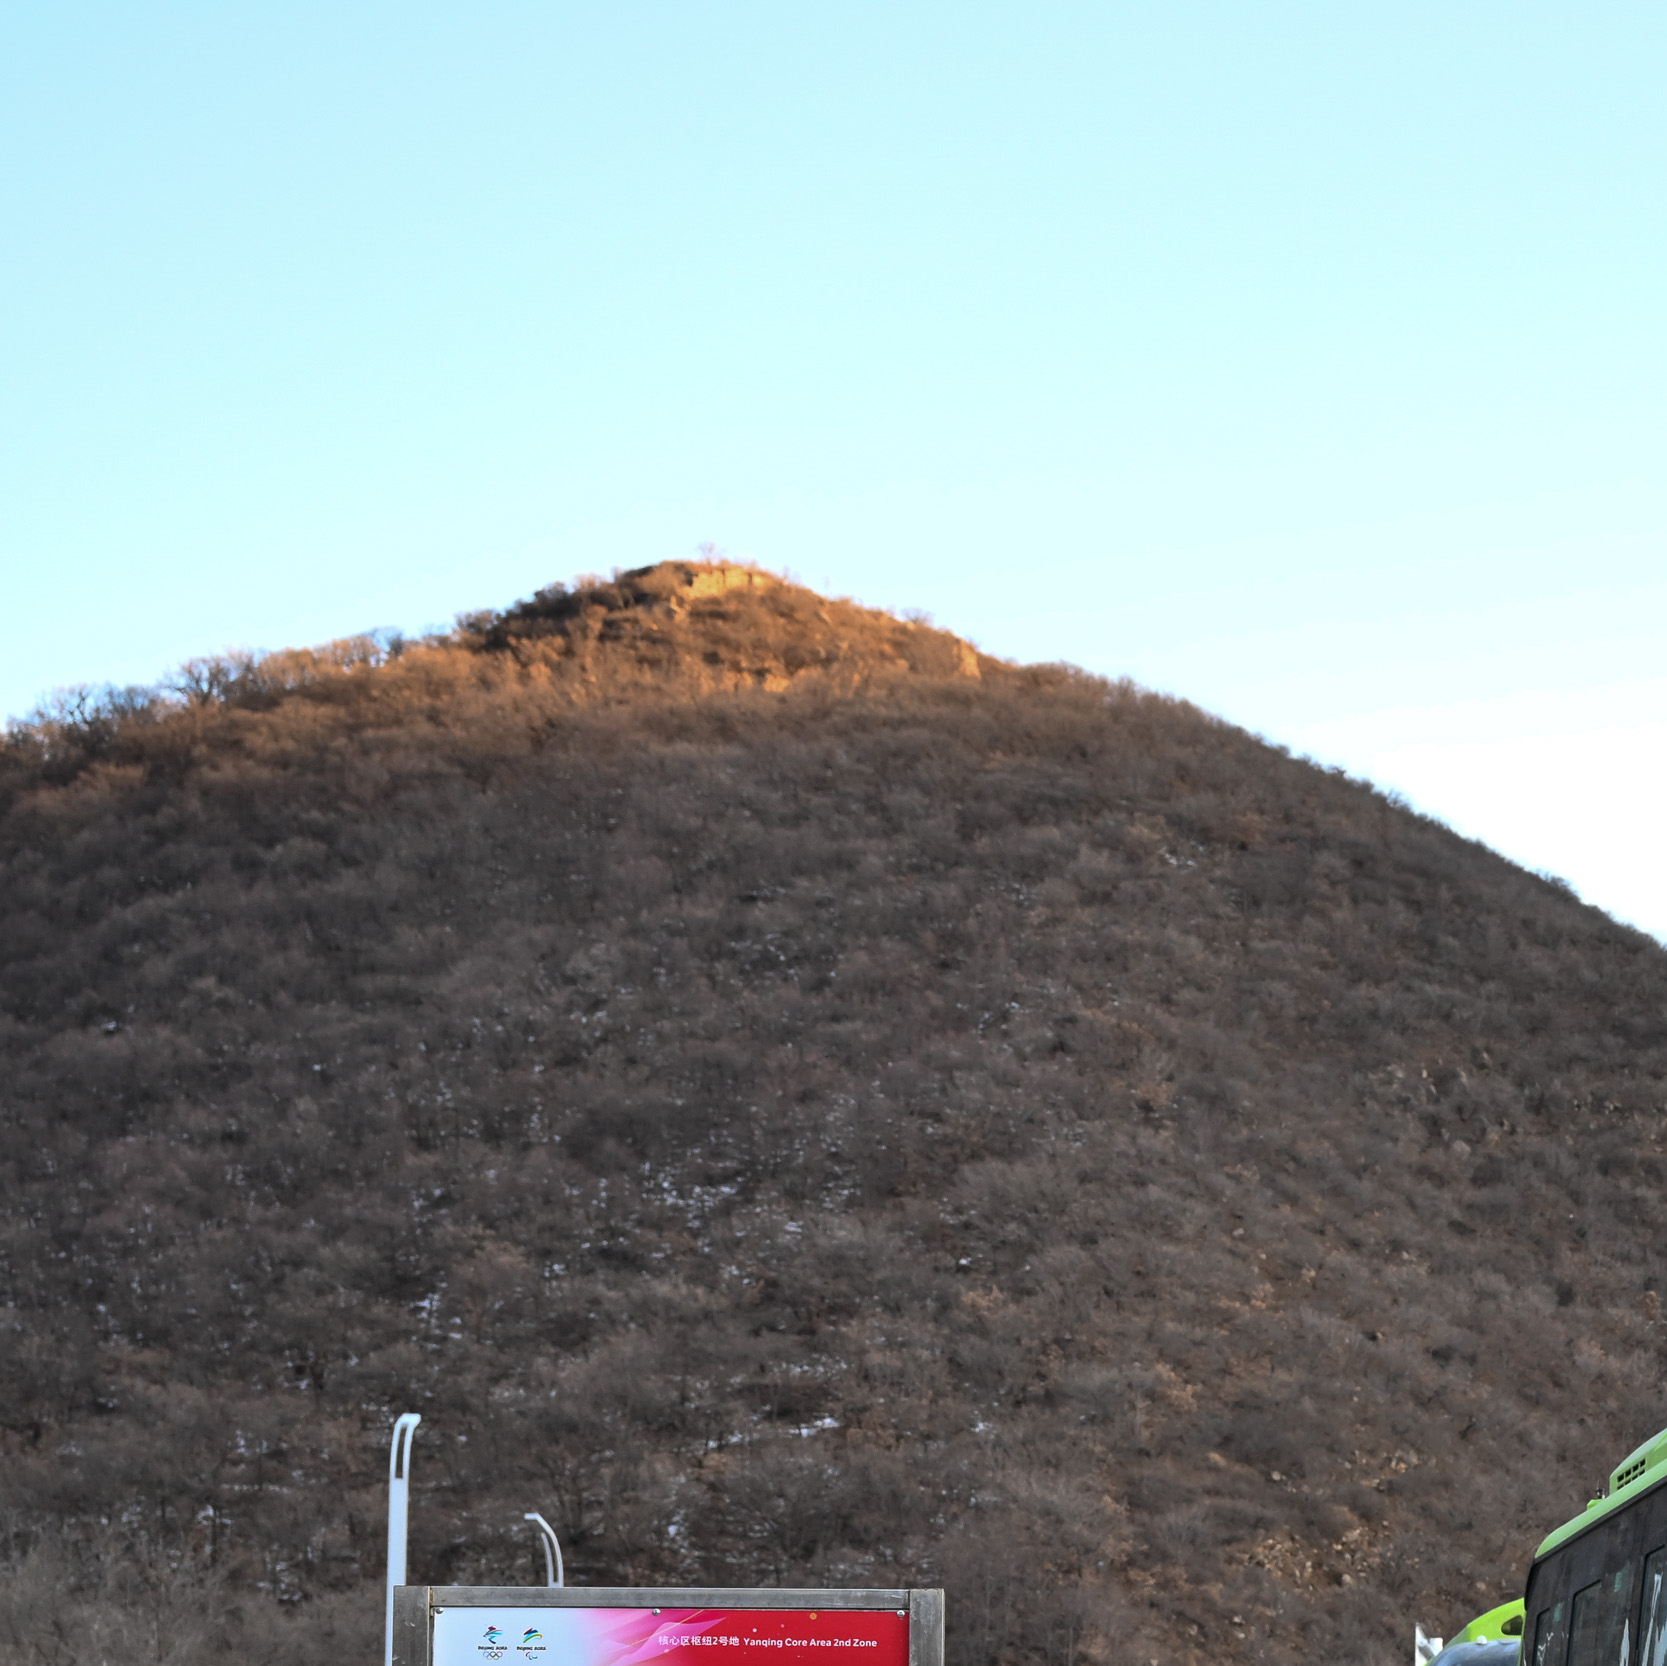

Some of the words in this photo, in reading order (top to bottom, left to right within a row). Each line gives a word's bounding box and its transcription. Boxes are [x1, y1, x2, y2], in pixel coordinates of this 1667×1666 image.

[658, 1636, 740, 1646] 核心区枢纽2号地
[743, 1638, 783, 1649] Yanqing
[785, 1638, 808, 1647] Core
[809, 1638, 832, 1647] Area
[833, 1638, 851, 1647] 2nd
[852, 1639, 878, 1647] Zone
